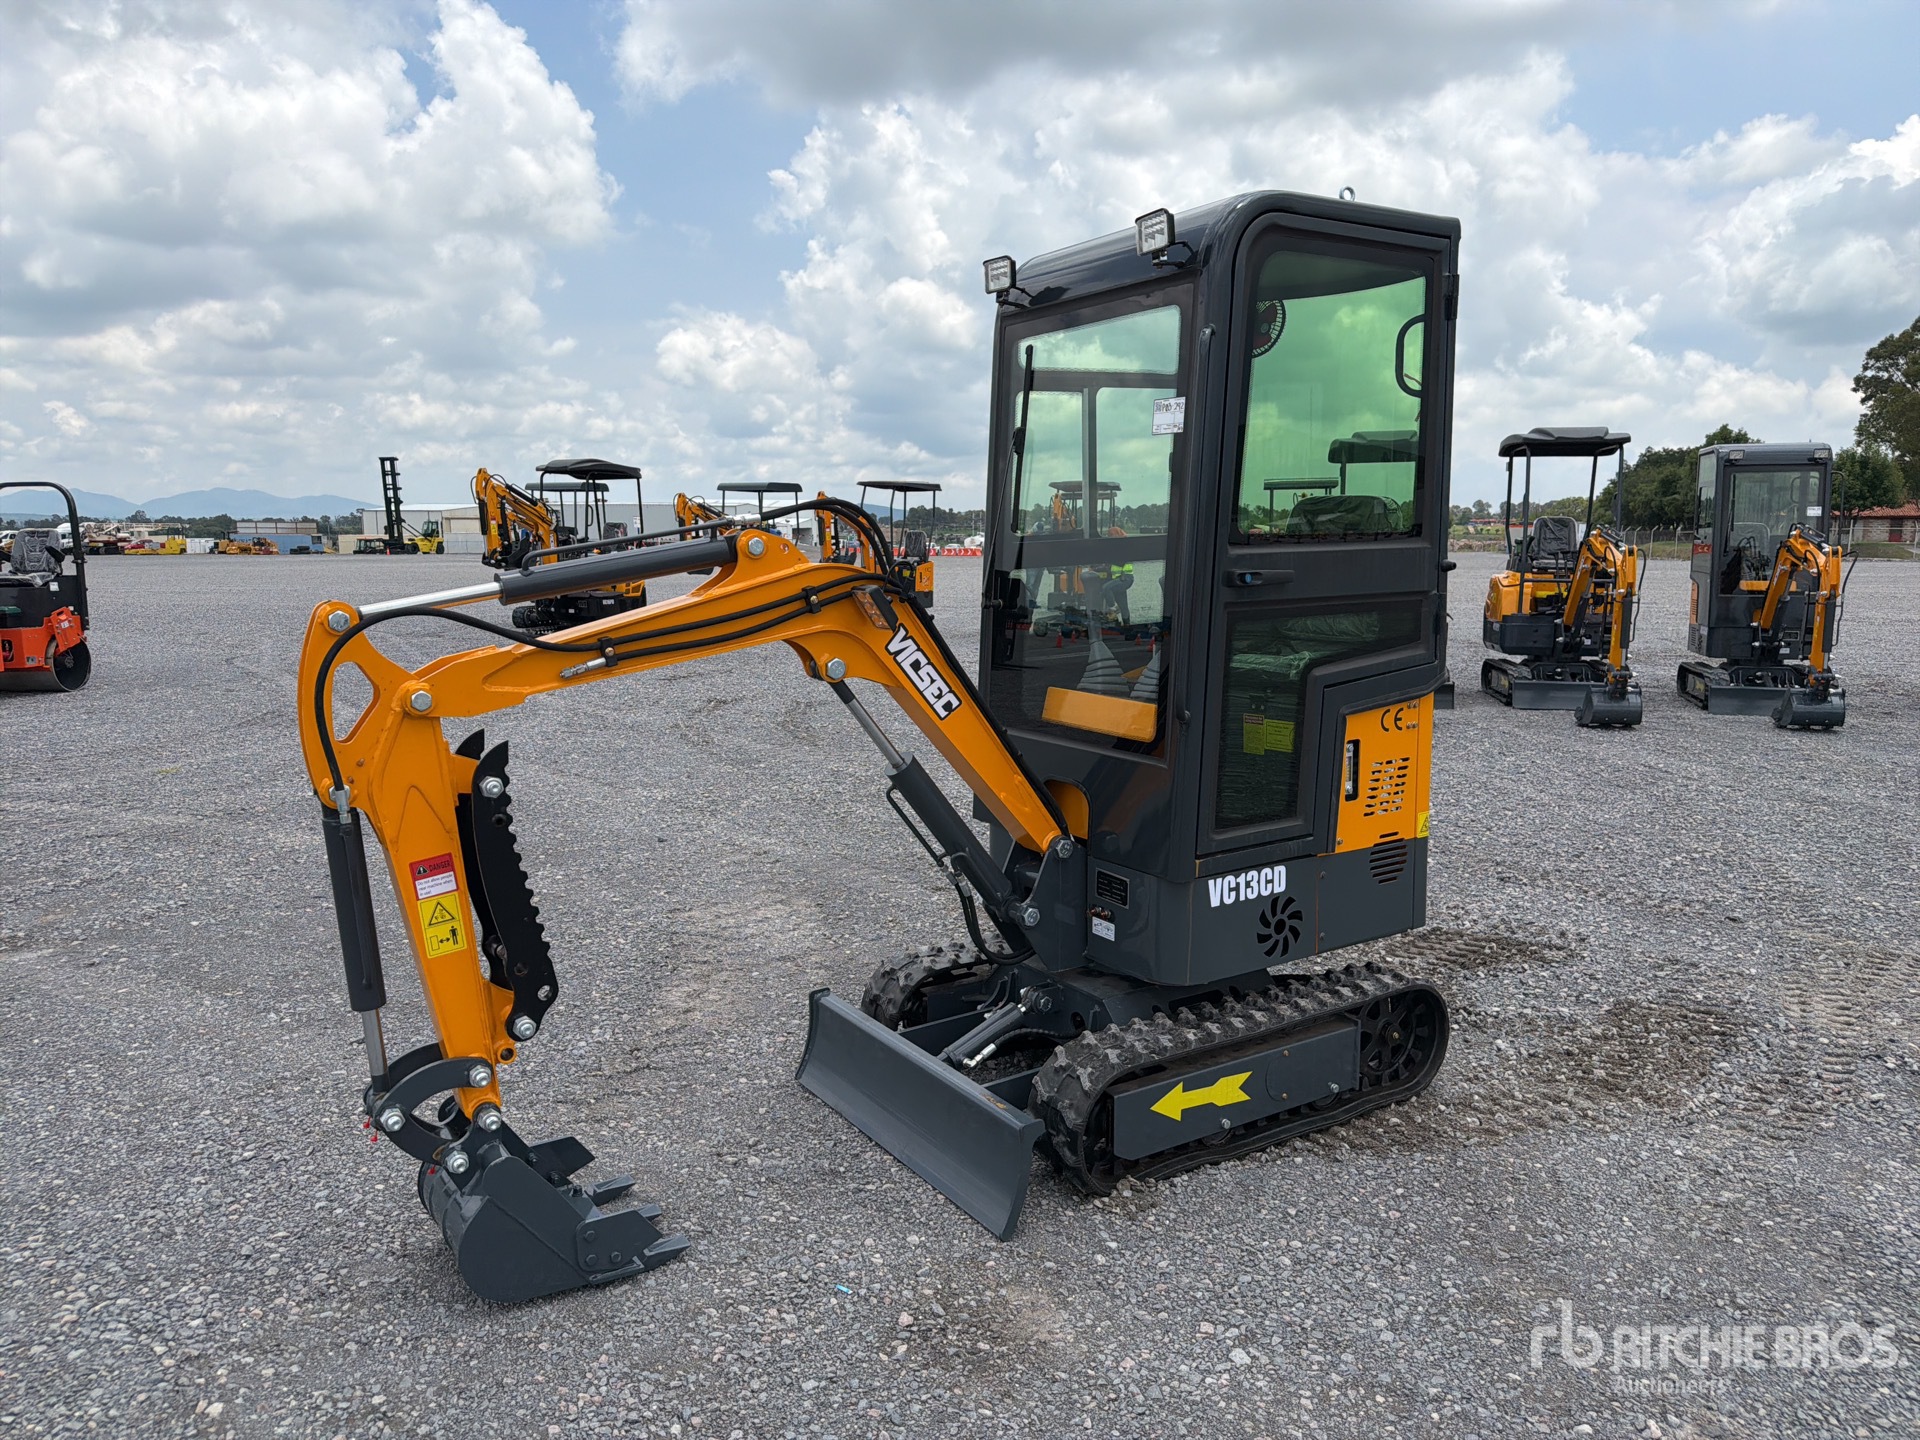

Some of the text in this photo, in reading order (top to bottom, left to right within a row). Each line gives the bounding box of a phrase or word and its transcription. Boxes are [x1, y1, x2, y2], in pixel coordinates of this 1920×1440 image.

[886, 625, 960, 719] VICSEC
[1380, 707, 1404, 732] CE
[429, 860, 451, 872] DANGER
[440, 873, 453, 881] people
[1208, 865, 1287, 908] VC13CD
